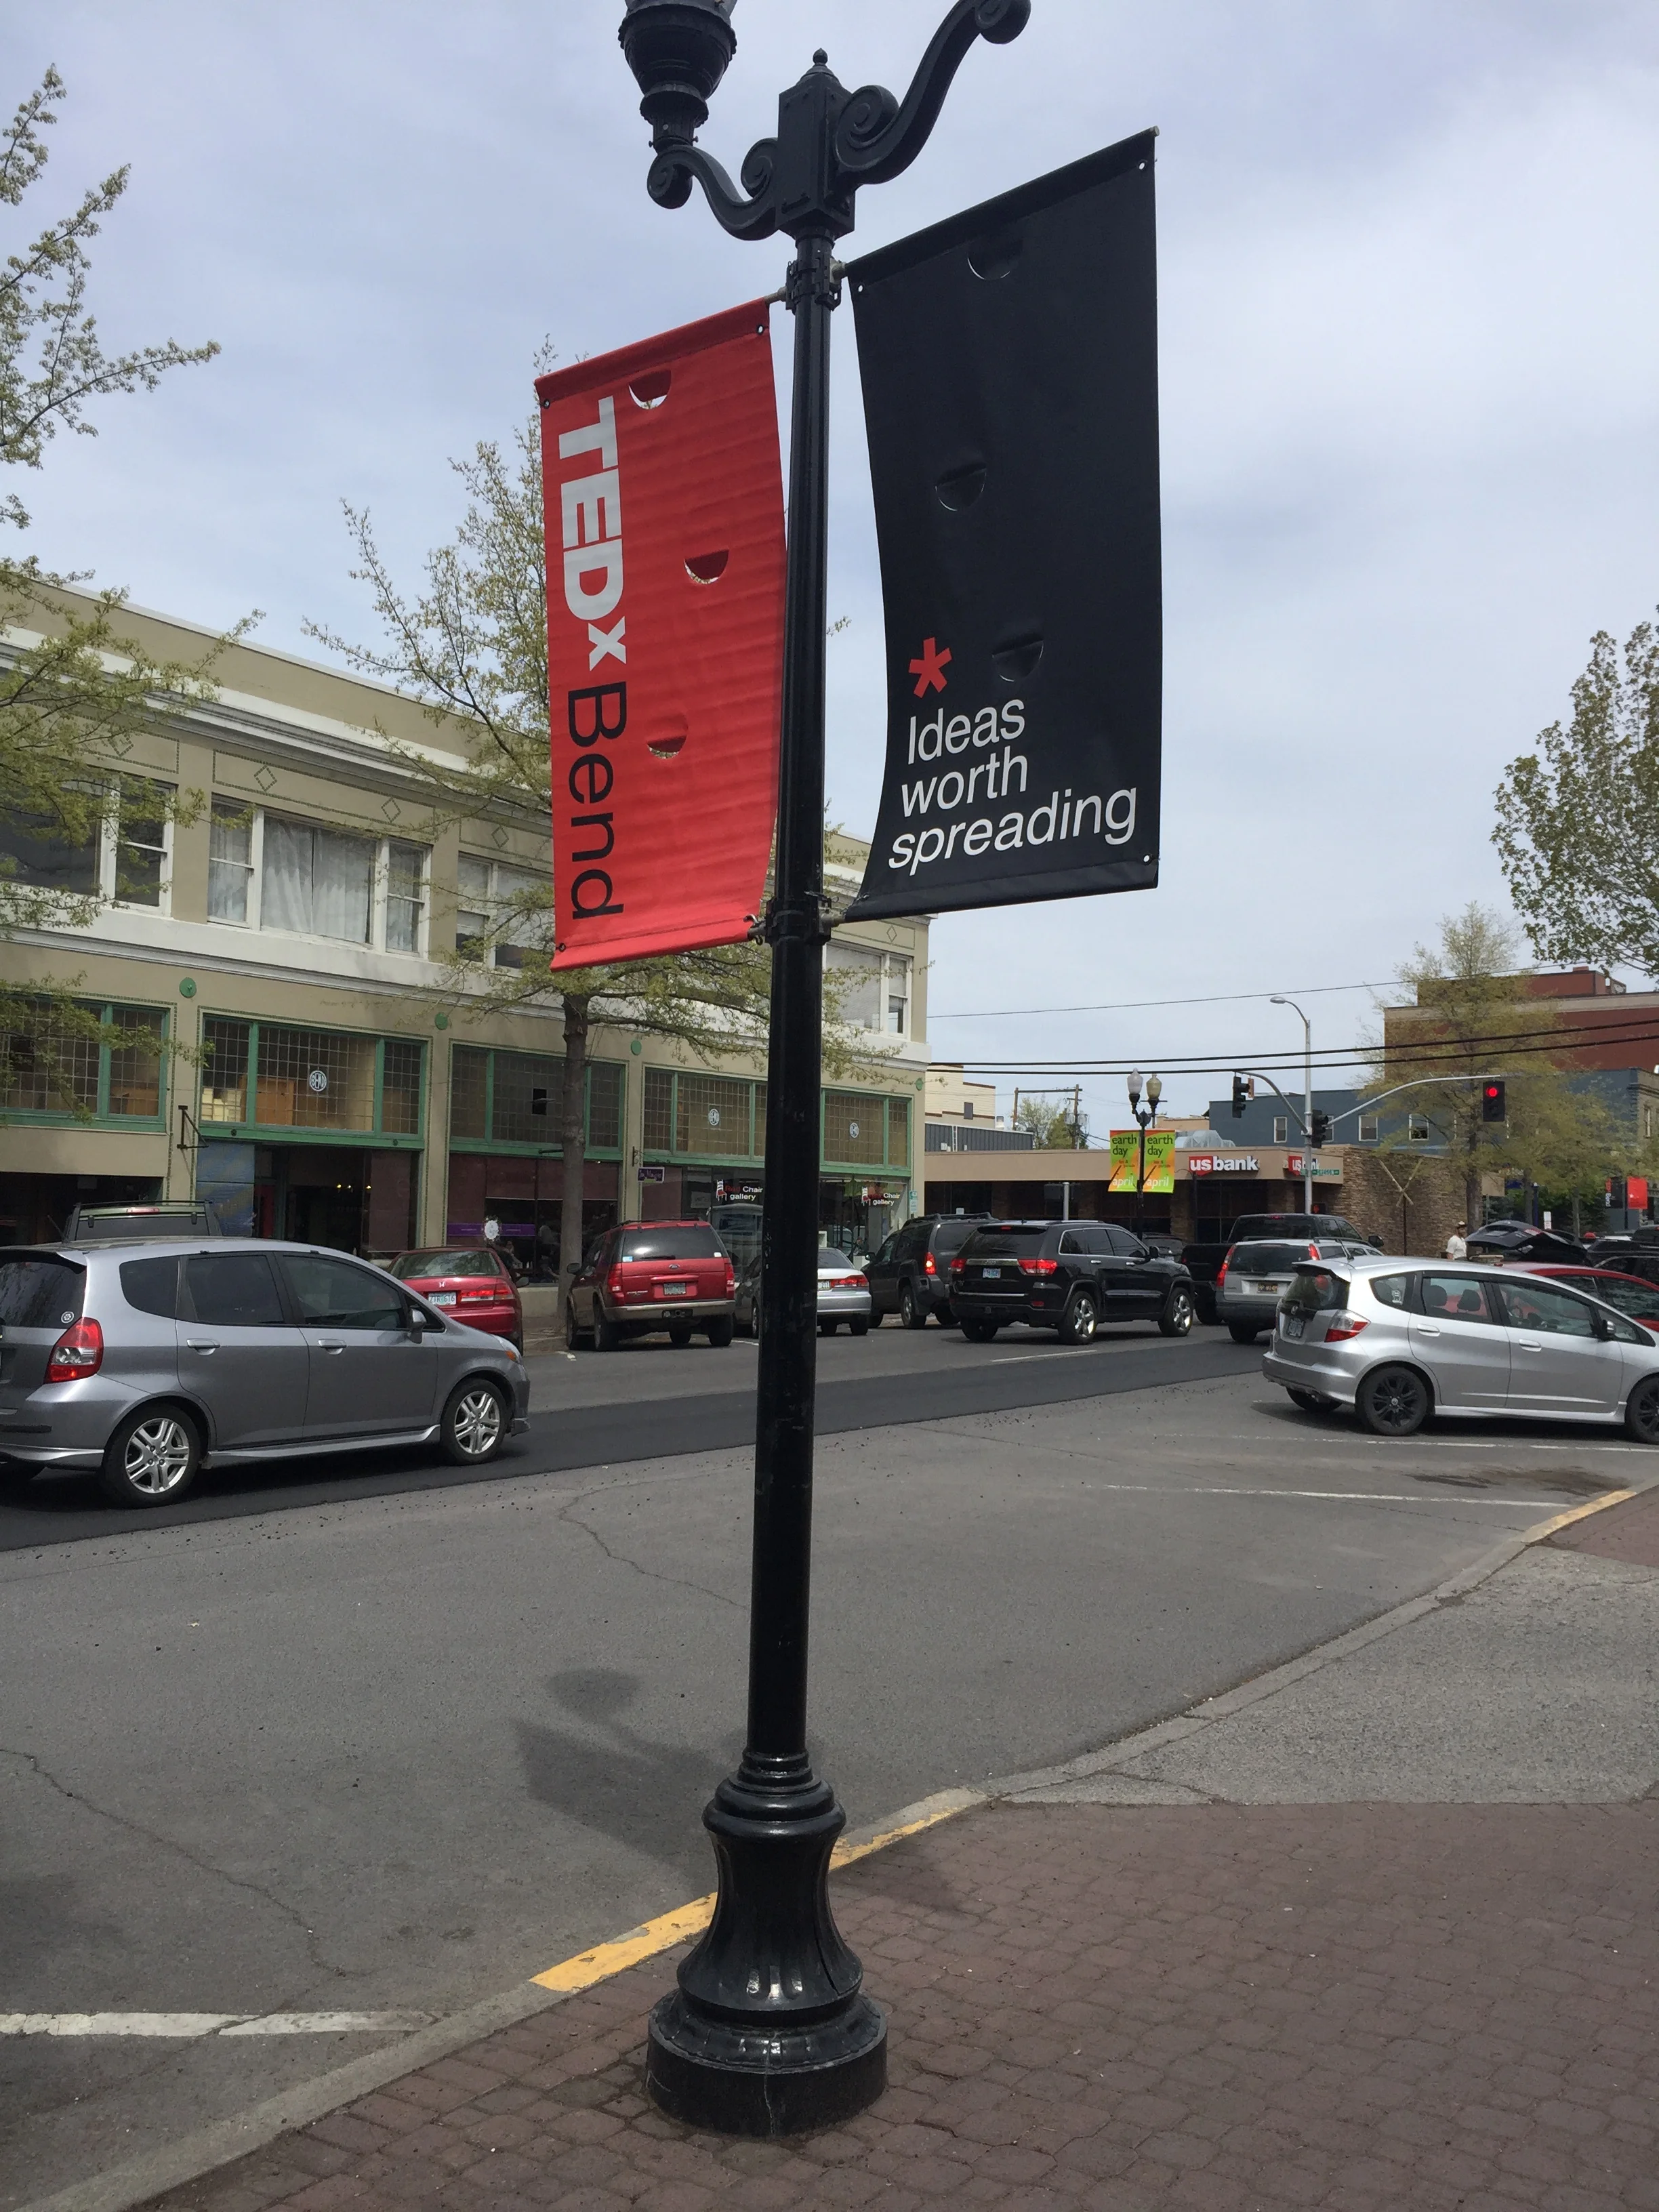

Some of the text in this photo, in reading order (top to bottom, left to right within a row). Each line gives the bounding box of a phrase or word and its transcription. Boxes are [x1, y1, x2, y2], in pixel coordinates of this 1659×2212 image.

[908, 699, 1025, 765] Ideas
[901, 746, 1027, 817] worth
[888, 787, 1136, 876] spreading
[1112, 1134, 1137, 1145] earth
[1147, 1134, 1173, 1145] earth
[1112, 1145, 1128, 1158] day
[1147, 1145, 1163, 1158] day
[1112, 1176, 1134, 1188] april
[1146, 1176, 1169, 1189] april
